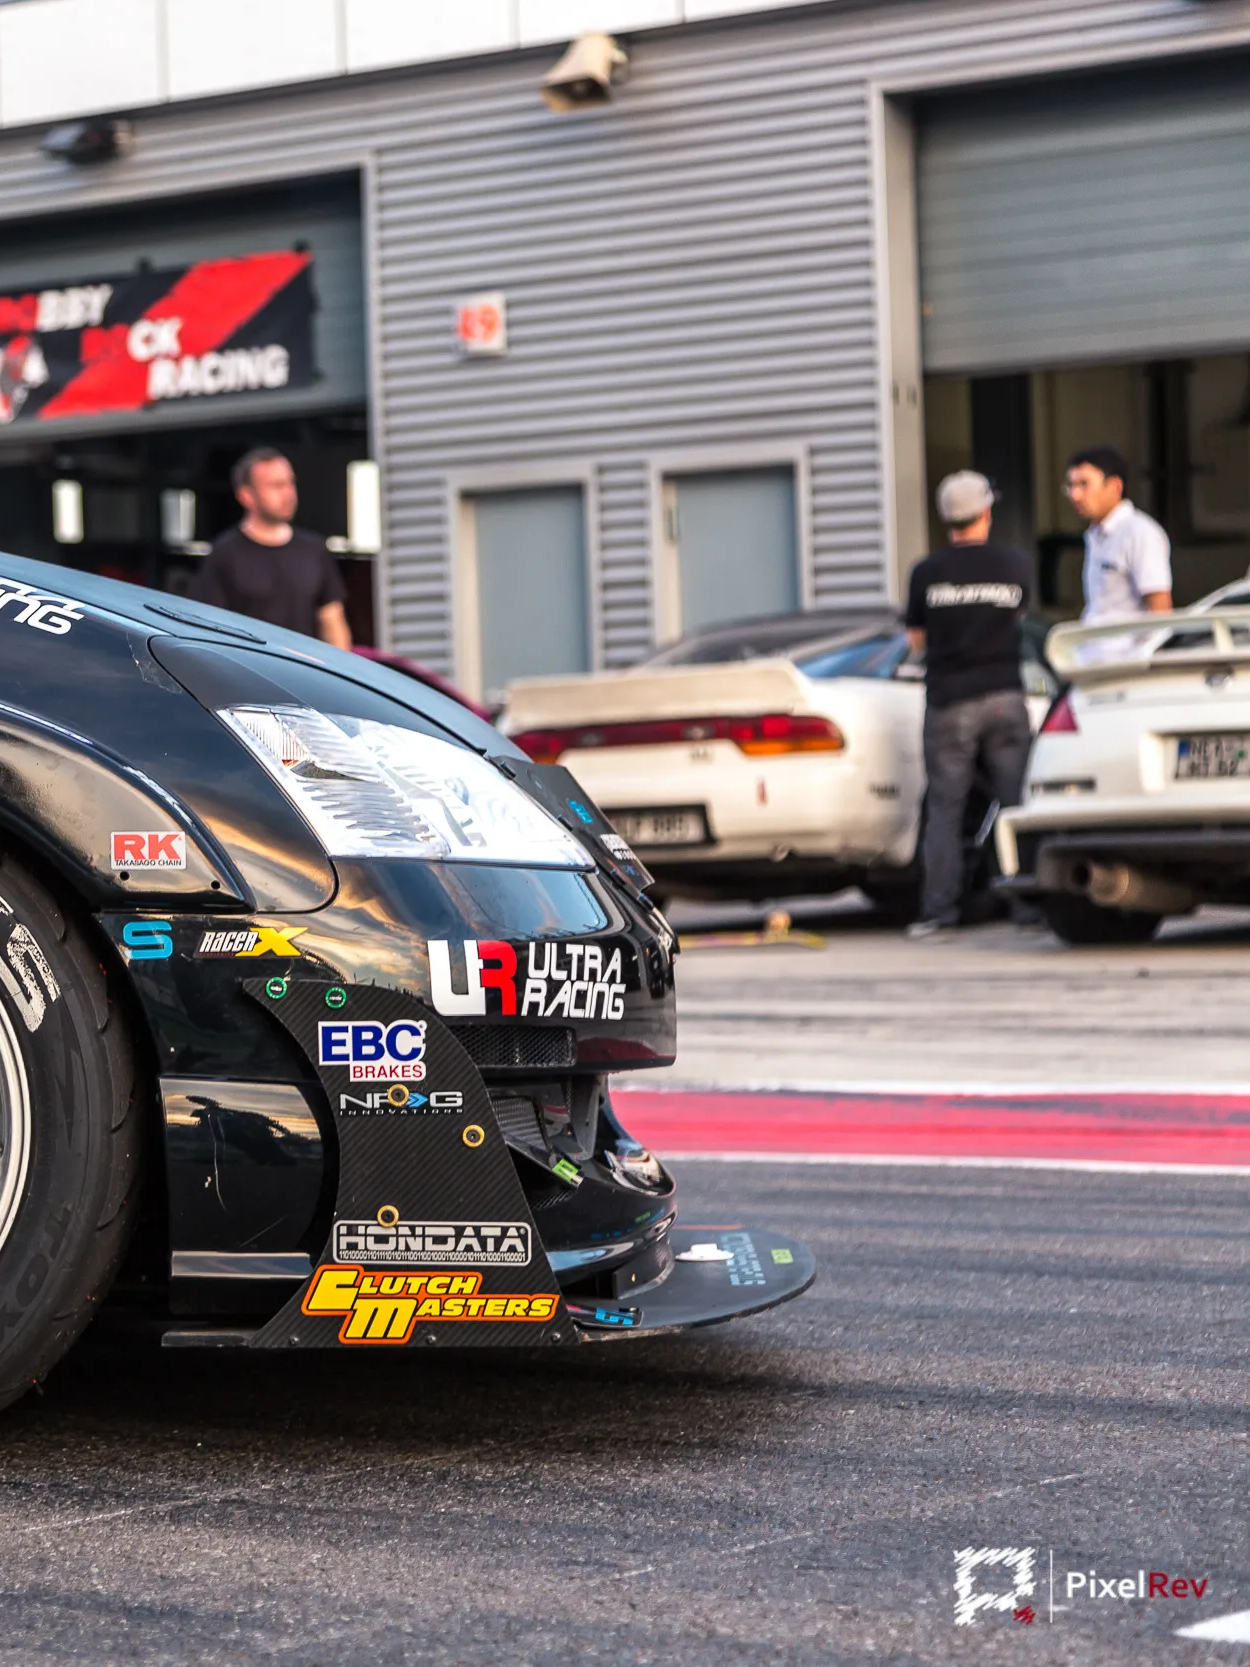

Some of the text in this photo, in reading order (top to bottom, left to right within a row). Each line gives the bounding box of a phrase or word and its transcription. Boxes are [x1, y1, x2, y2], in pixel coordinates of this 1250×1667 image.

[147, 344, 289, 398] RACING
[113, 834, 182, 860] RK
[115, 859, 182, 867] TAKASAGO CHAIN
[528, 941, 622, 983] ULTRA
[521, 978, 626, 1020] RACING
[321, 1024, 422, 1062] EBC
[353, 1065, 423, 1079] BRAKES
[340, 1108, 463, 1116] INNOVATIONS
[340, 1226, 525, 1251] HONDATA
[308, 1270, 478, 1310] CLUTCH
[345, 1298, 553, 1338] MASTERS
